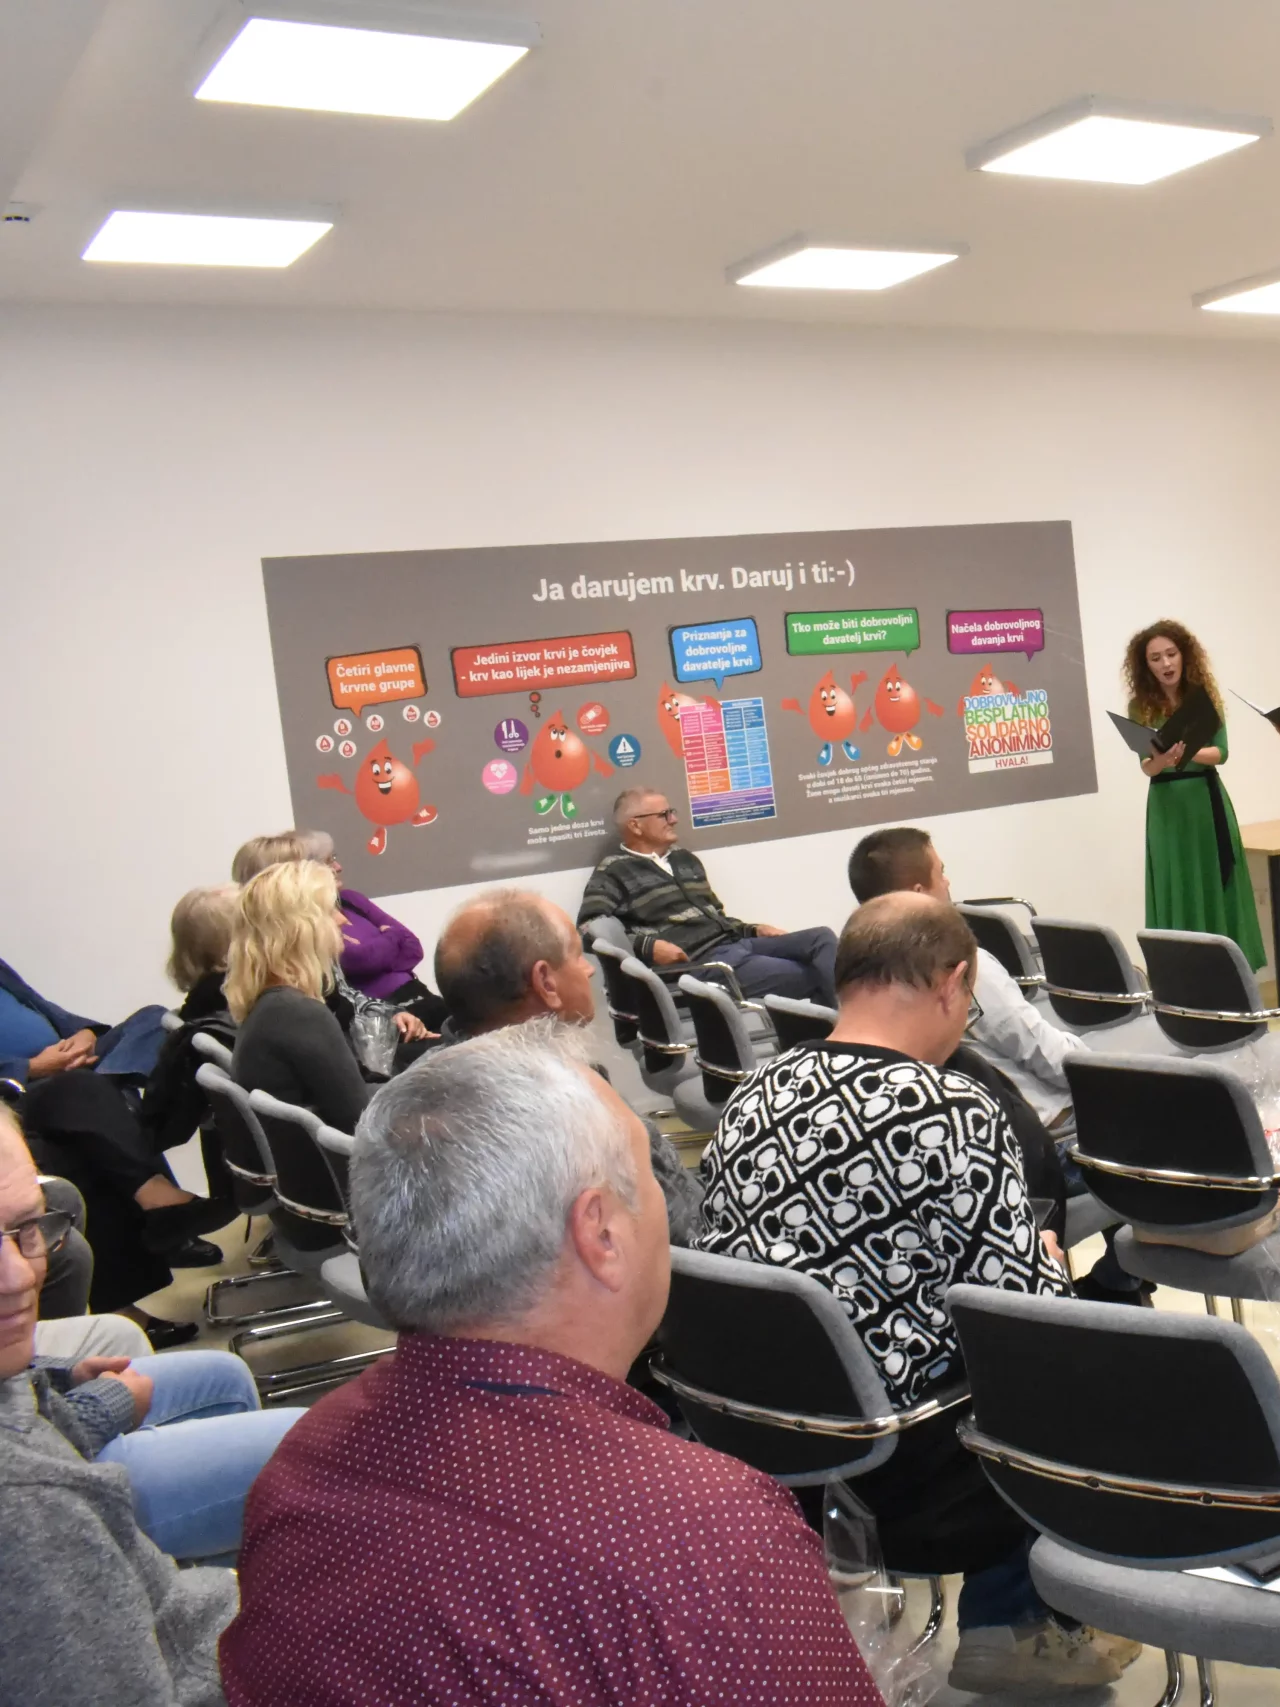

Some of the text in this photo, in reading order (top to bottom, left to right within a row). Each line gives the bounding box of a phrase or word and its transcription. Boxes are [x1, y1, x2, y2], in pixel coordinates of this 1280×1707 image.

[532, 559, 856, 602] Ja darujem krv. Daruj i ti:-)
[792, 613, 913, 633] Tko može biti dobrovoljni
[951, 618, 1041, 634] Načela dobrovoljnog
[682, 628, 747, 642] Priznanja za
[822, 630, 887, 645] davatelj krvi?
[971, 631, 1025, 647] davanja krvi
[473, 644, 618, 666] Jedini izvor krvi je čovjek
[685, 642, 747, 657] dobrovoljne
[336, 662, 415, 677] Četiri glavne
[469, 671, 489, 682] krv
[491, 668, 514, 680] kao
[516, 666, 541, 681] lijek
[543, 665, 554, 679] je
[556, 658, 631, 675] nezamjenjiva
[682, 655, 753, 672] davatelje krvi
[340, 679, 415, 694] krvne grupe
[964, 690, 1047, 710] DOBROVOLJNO
[965, 702, 1048, 725] BESPLATNO
[966, 717, 1050, 741] SOLIDARNO
[969, 733, 1052, 758] ANONIMNO
[995, 756, 1029, 768] HVALA!
[528, 827, 550, 835] Samo
[550, 823, 571, 834] jedna
[574, 830, 582, 838] tri
